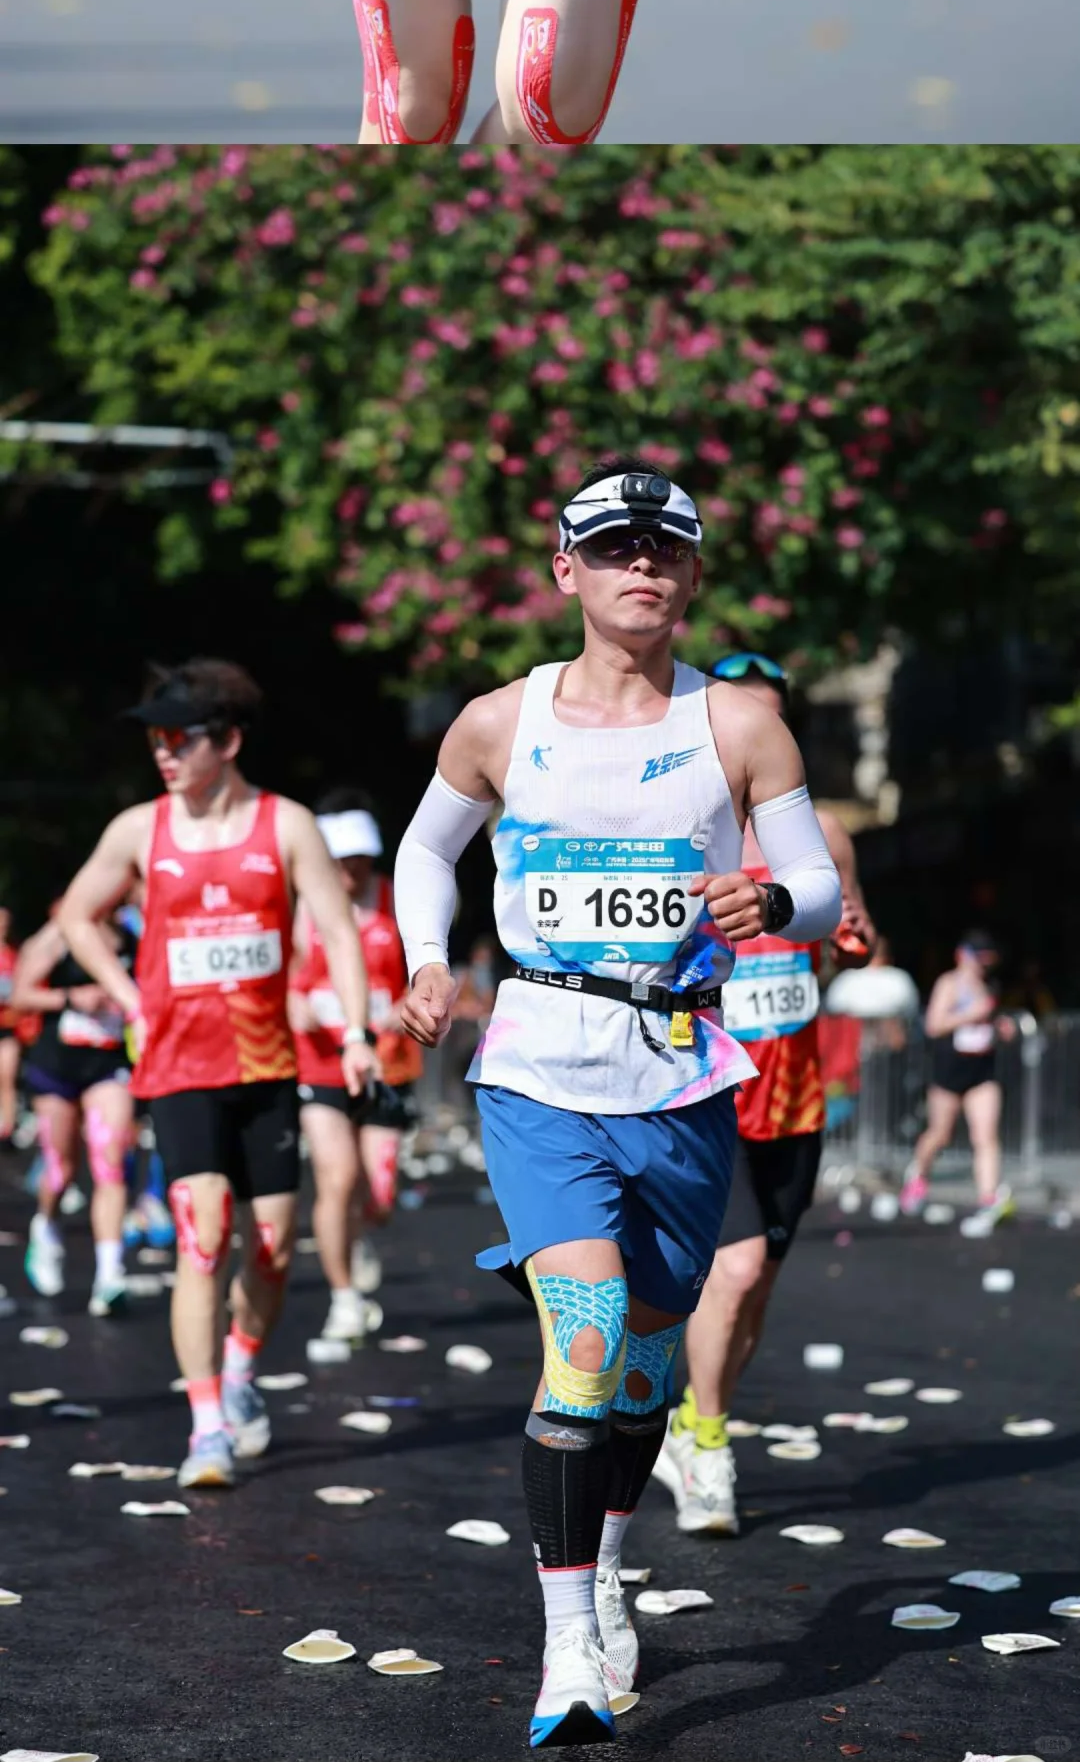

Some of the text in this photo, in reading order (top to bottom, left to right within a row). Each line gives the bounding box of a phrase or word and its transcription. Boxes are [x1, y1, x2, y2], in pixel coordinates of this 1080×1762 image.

[598, 841, 665, 852] 广汽丰田
[538, 888, 687, 929] D 1636
[208, 942, 271, 972] 0216
[602, 952, 621, 961] ANTA
[746, 982, 806, 1017] 1139
